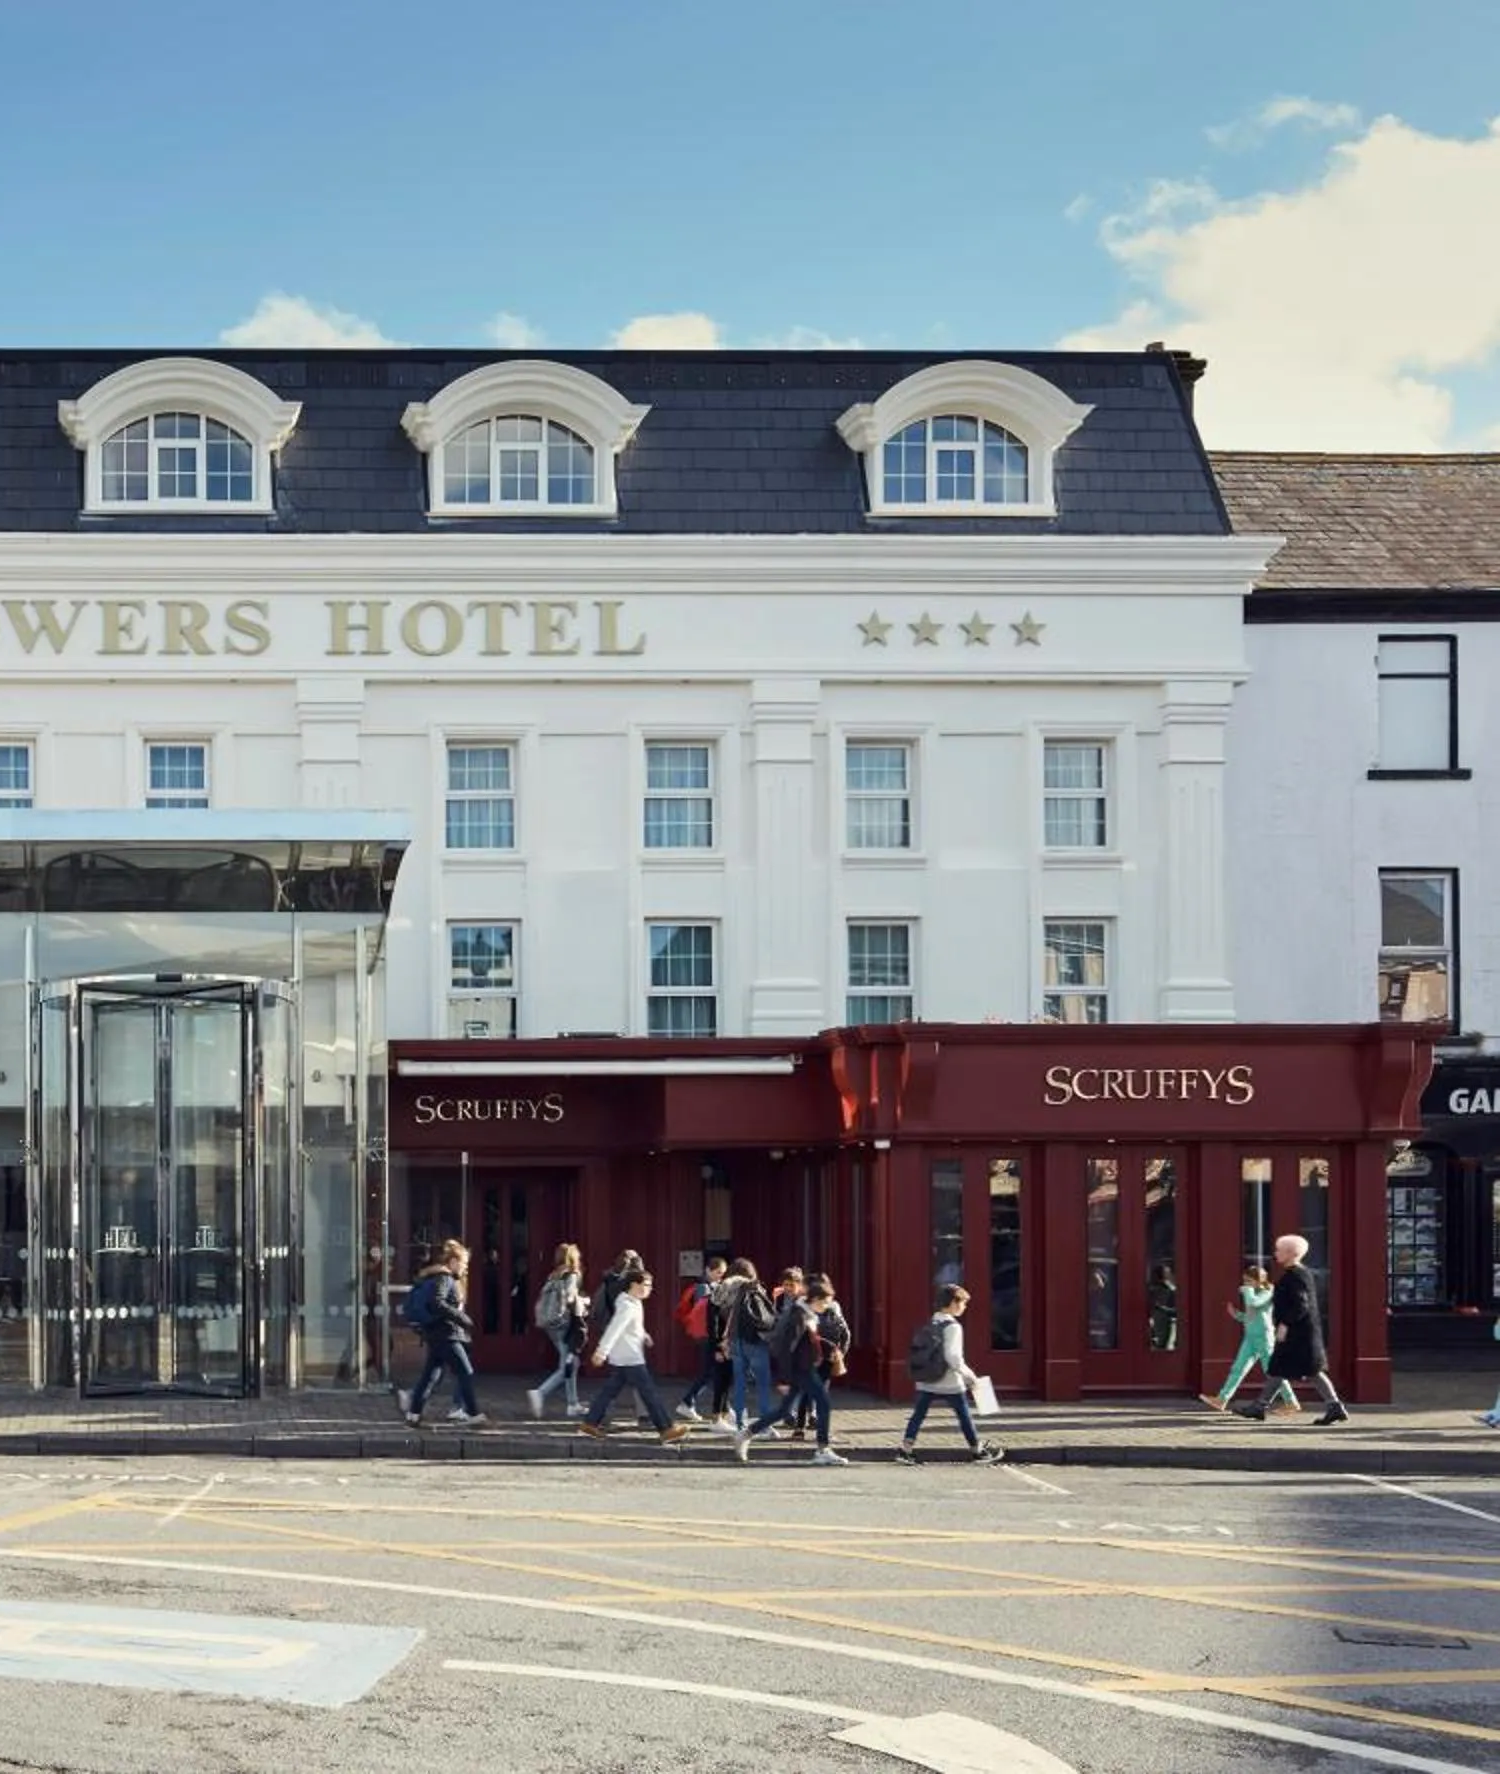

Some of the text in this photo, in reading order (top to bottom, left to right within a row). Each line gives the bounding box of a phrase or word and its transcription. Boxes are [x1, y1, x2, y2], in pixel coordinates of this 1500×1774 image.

[323, 598, 648, 657] HOTEL
[1043, 1064, 1256, 1105] SCRUFFYS
[414, 1093, 565, 1124] SCRUFFYS
